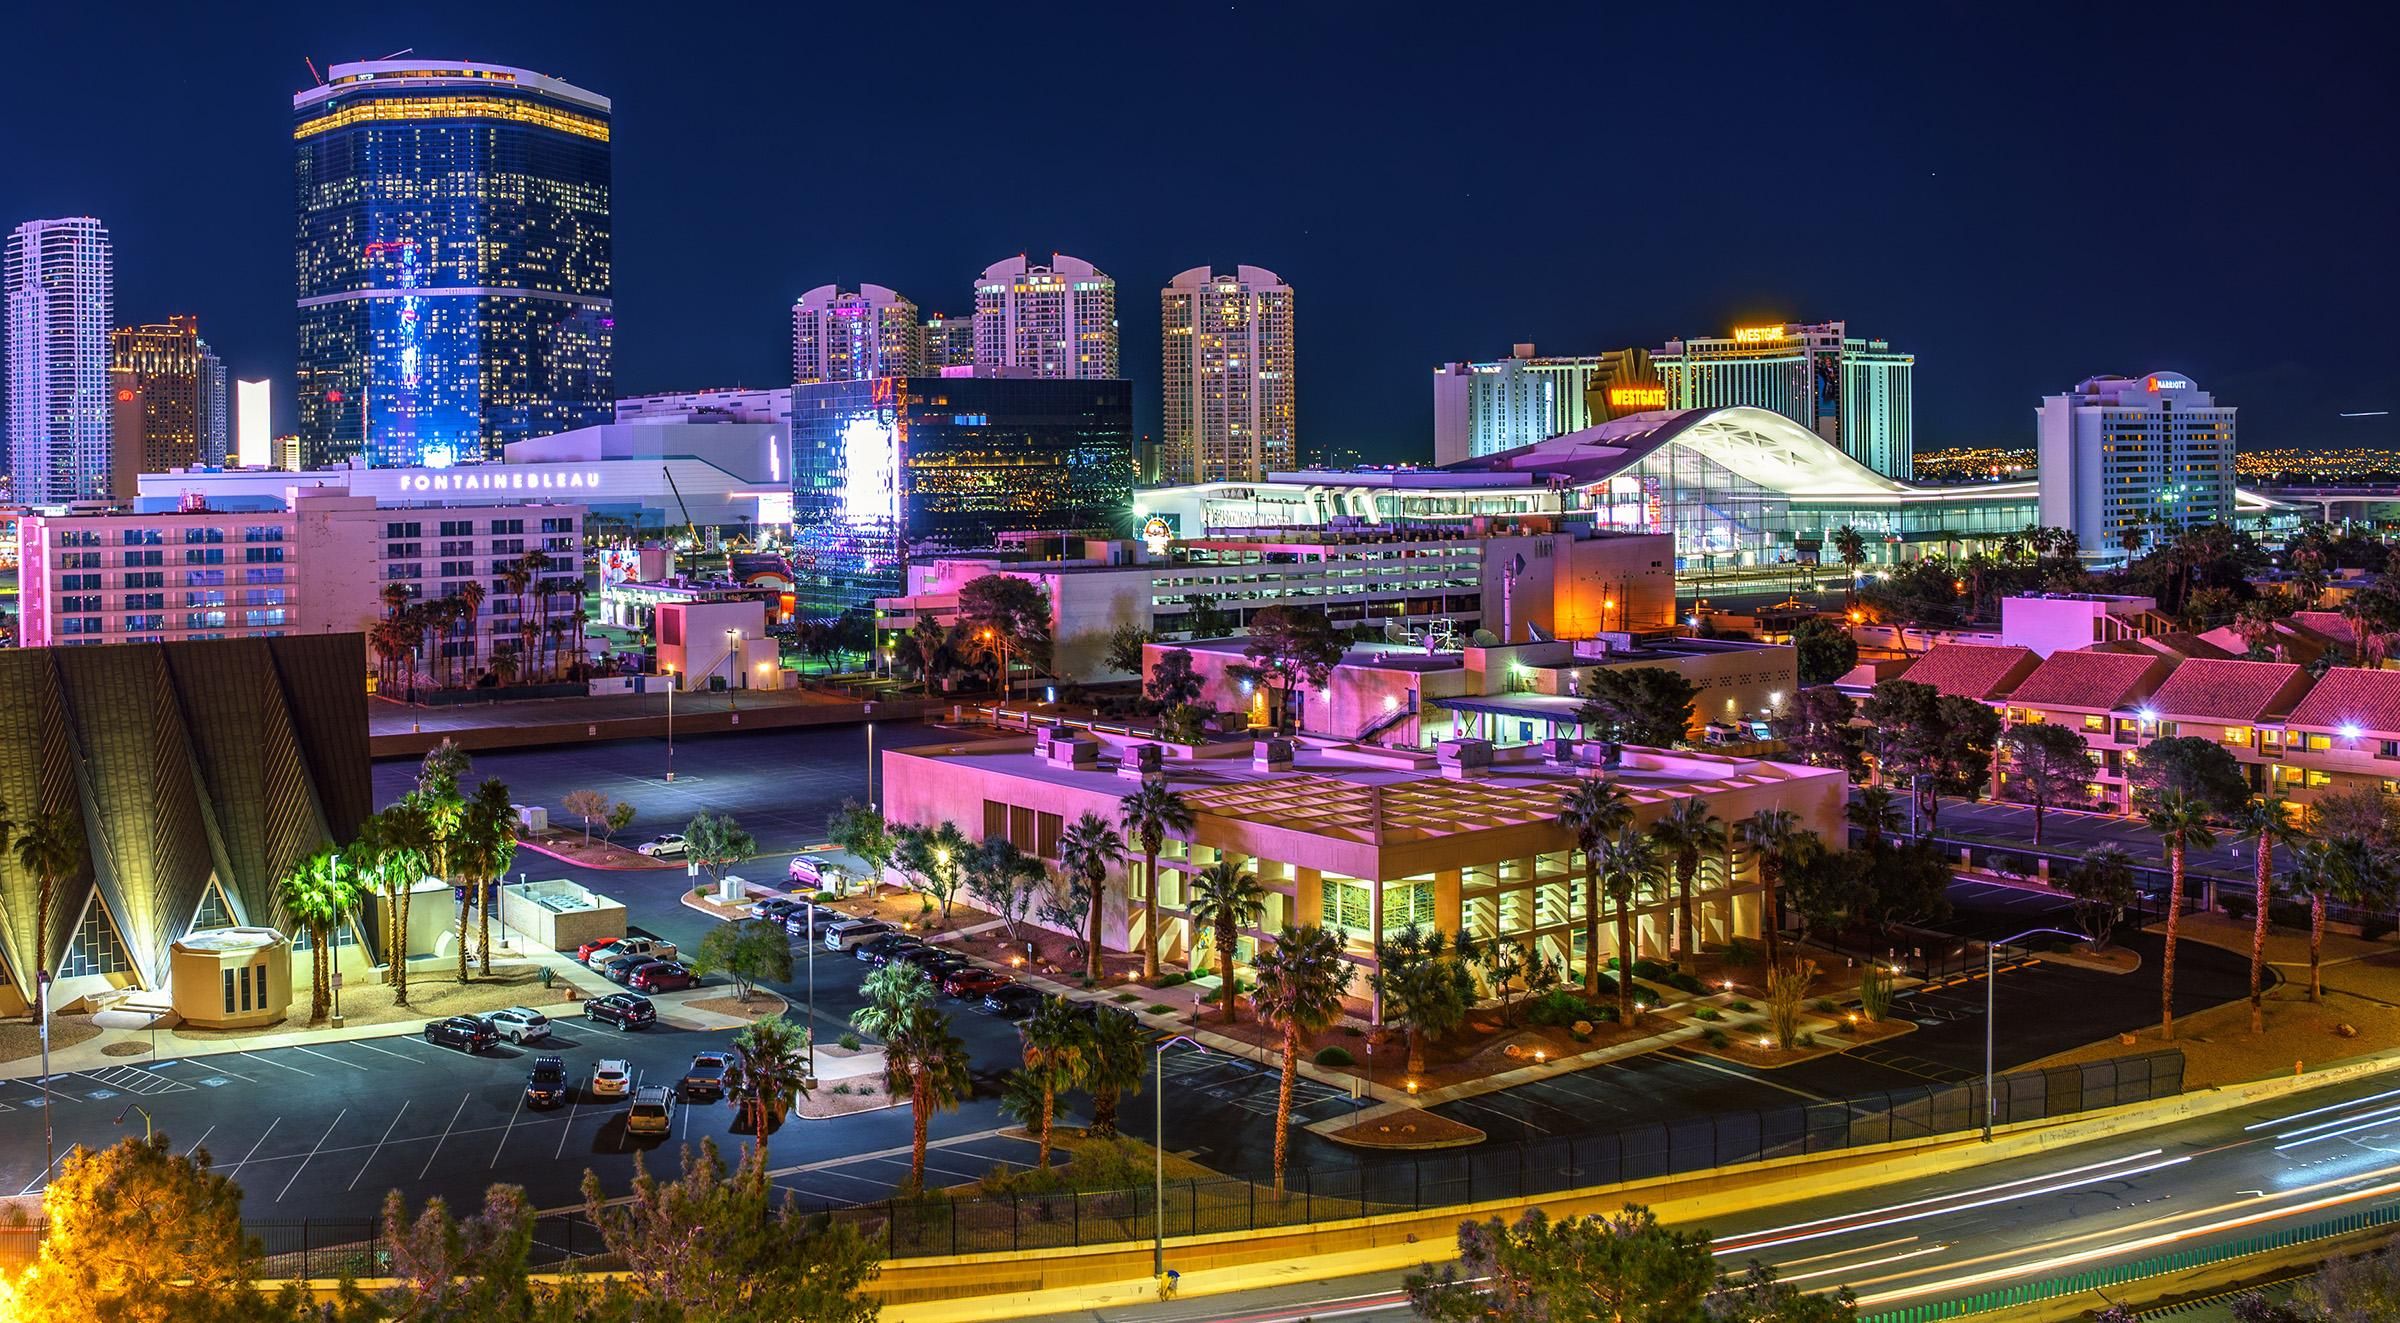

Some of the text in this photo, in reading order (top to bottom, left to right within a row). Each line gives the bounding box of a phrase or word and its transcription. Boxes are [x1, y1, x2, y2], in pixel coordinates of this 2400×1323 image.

[1734, 327, 1784, 342] WESTGATE
[2157, 380, 2187, 389] MARRIOTT
[1611, 389, 1666, 405] WESTGATE
[400, 473, 600, 490] FONTAINEBLEAU
